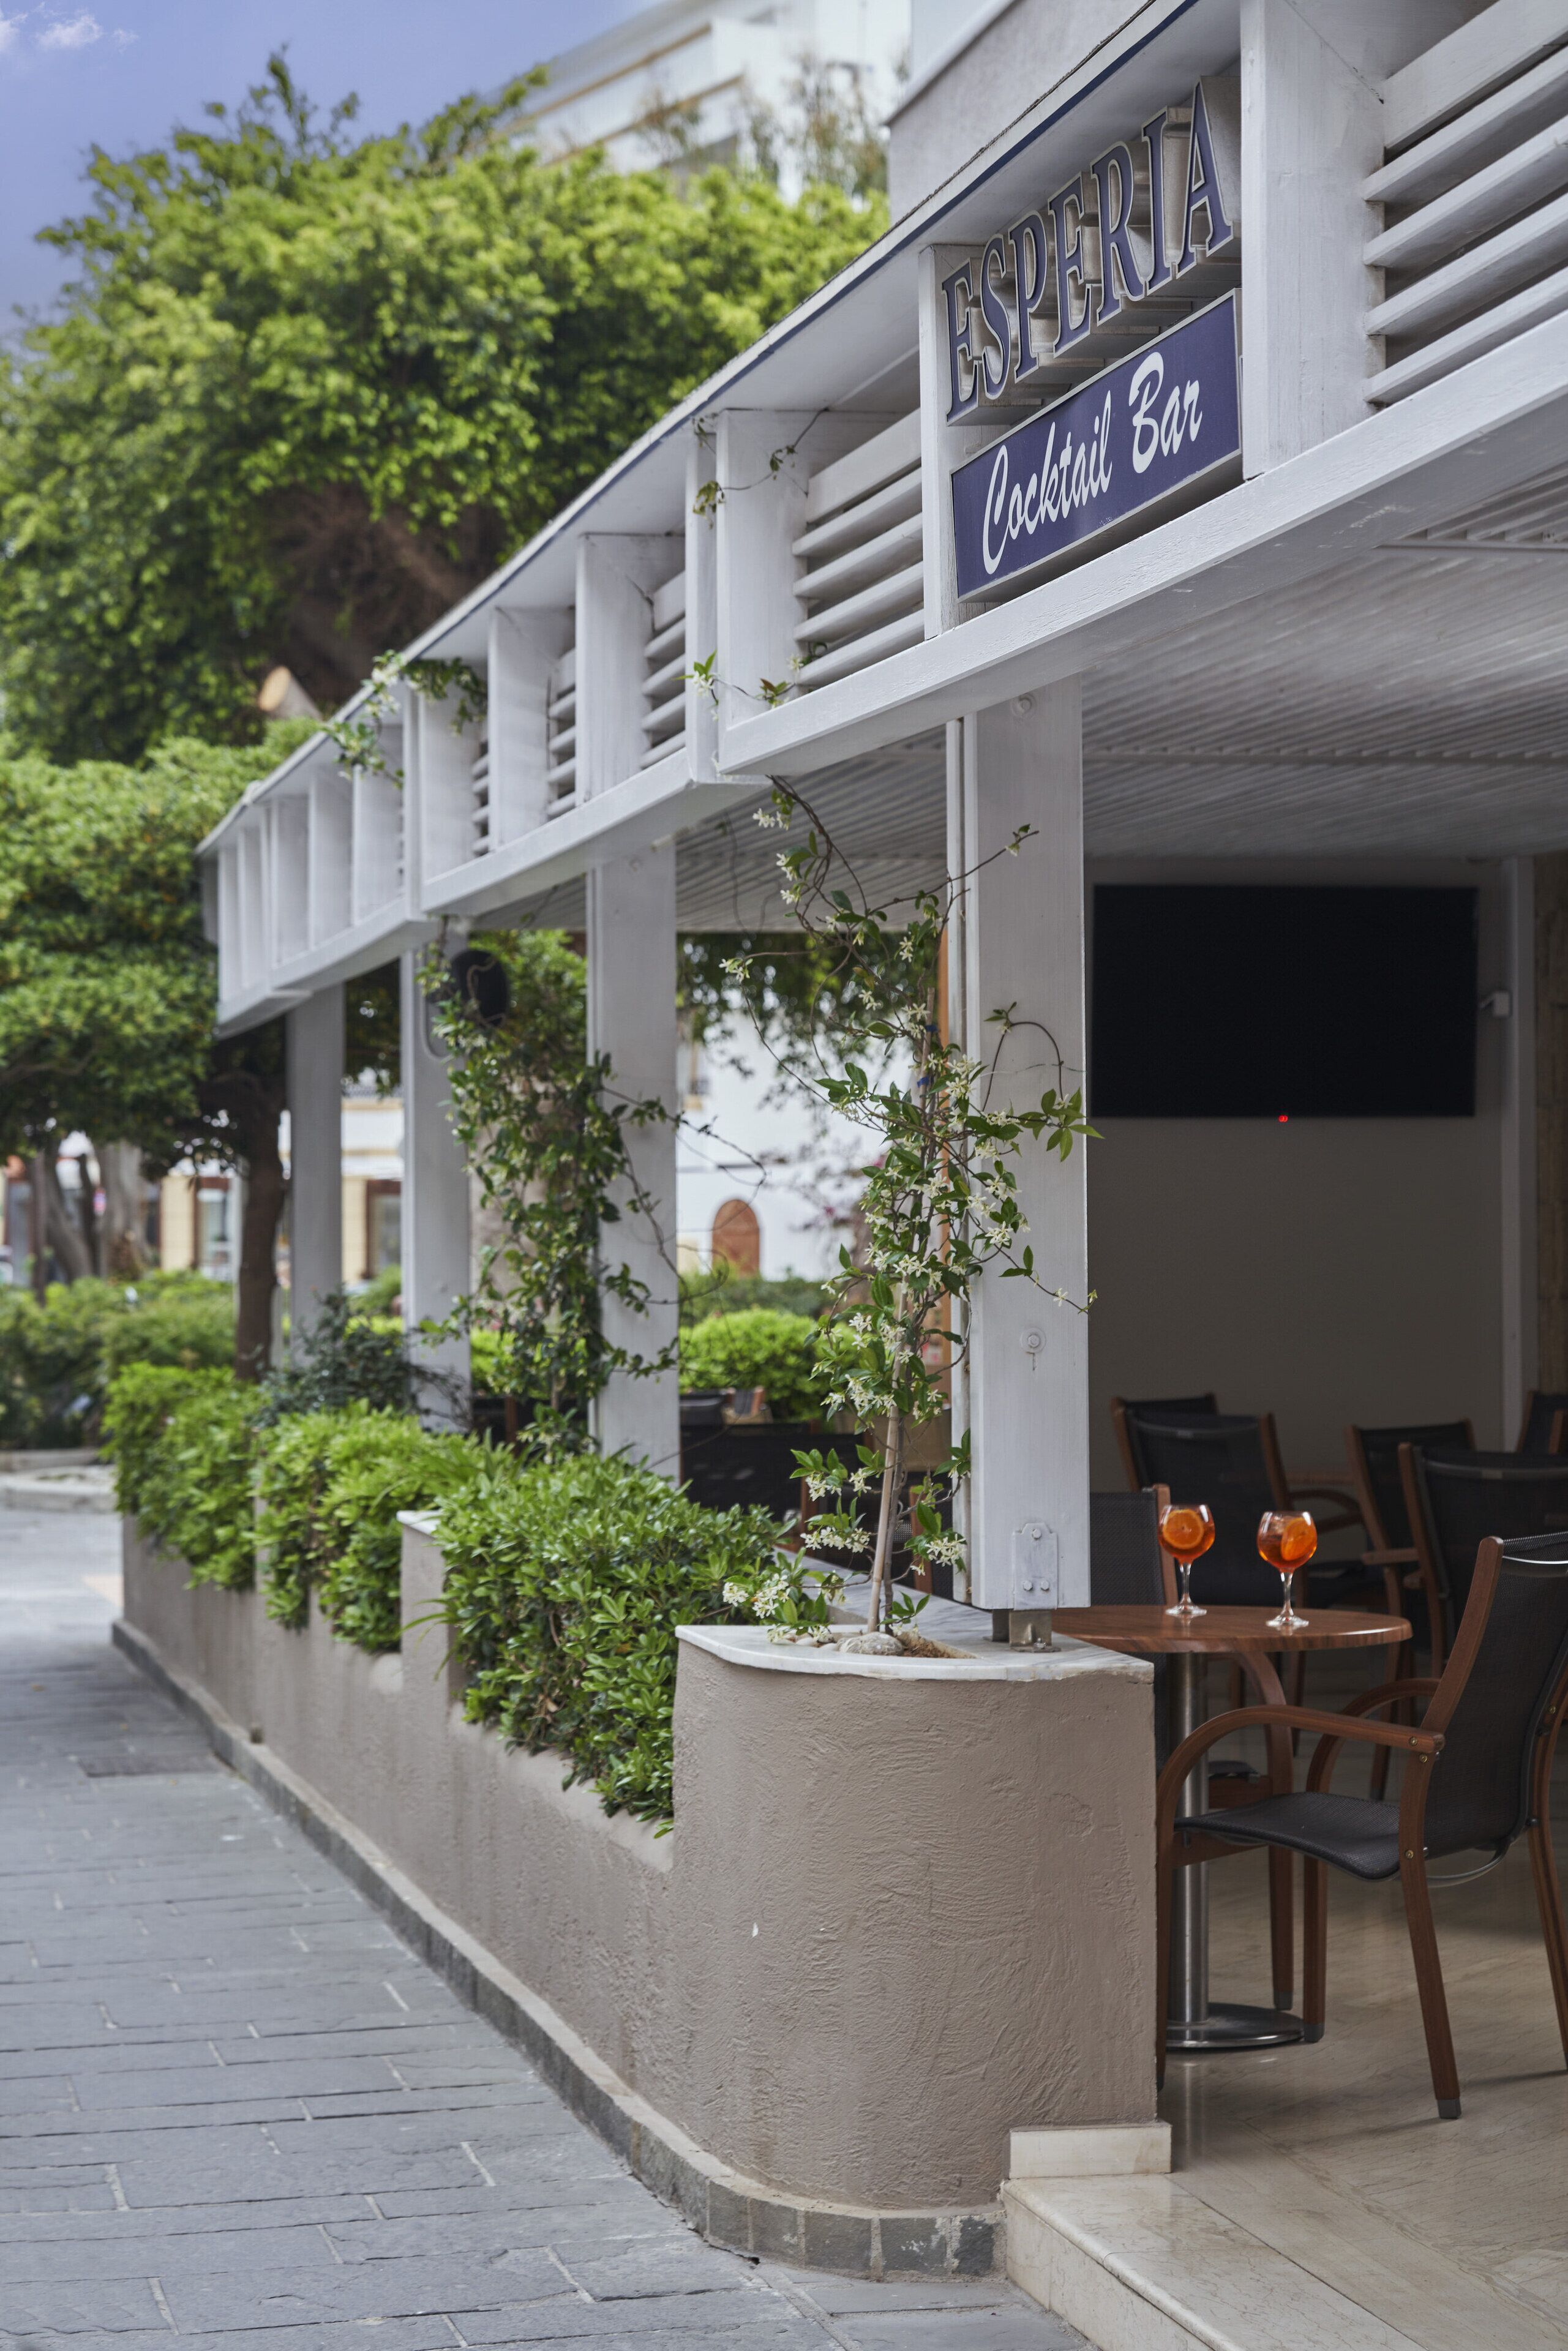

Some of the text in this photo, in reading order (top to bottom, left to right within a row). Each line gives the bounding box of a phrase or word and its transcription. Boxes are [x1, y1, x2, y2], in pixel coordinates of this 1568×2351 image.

[942, 76, 1234, 427] ESPERIA
[983, 351, 1202, 574] Cocktail Bar
